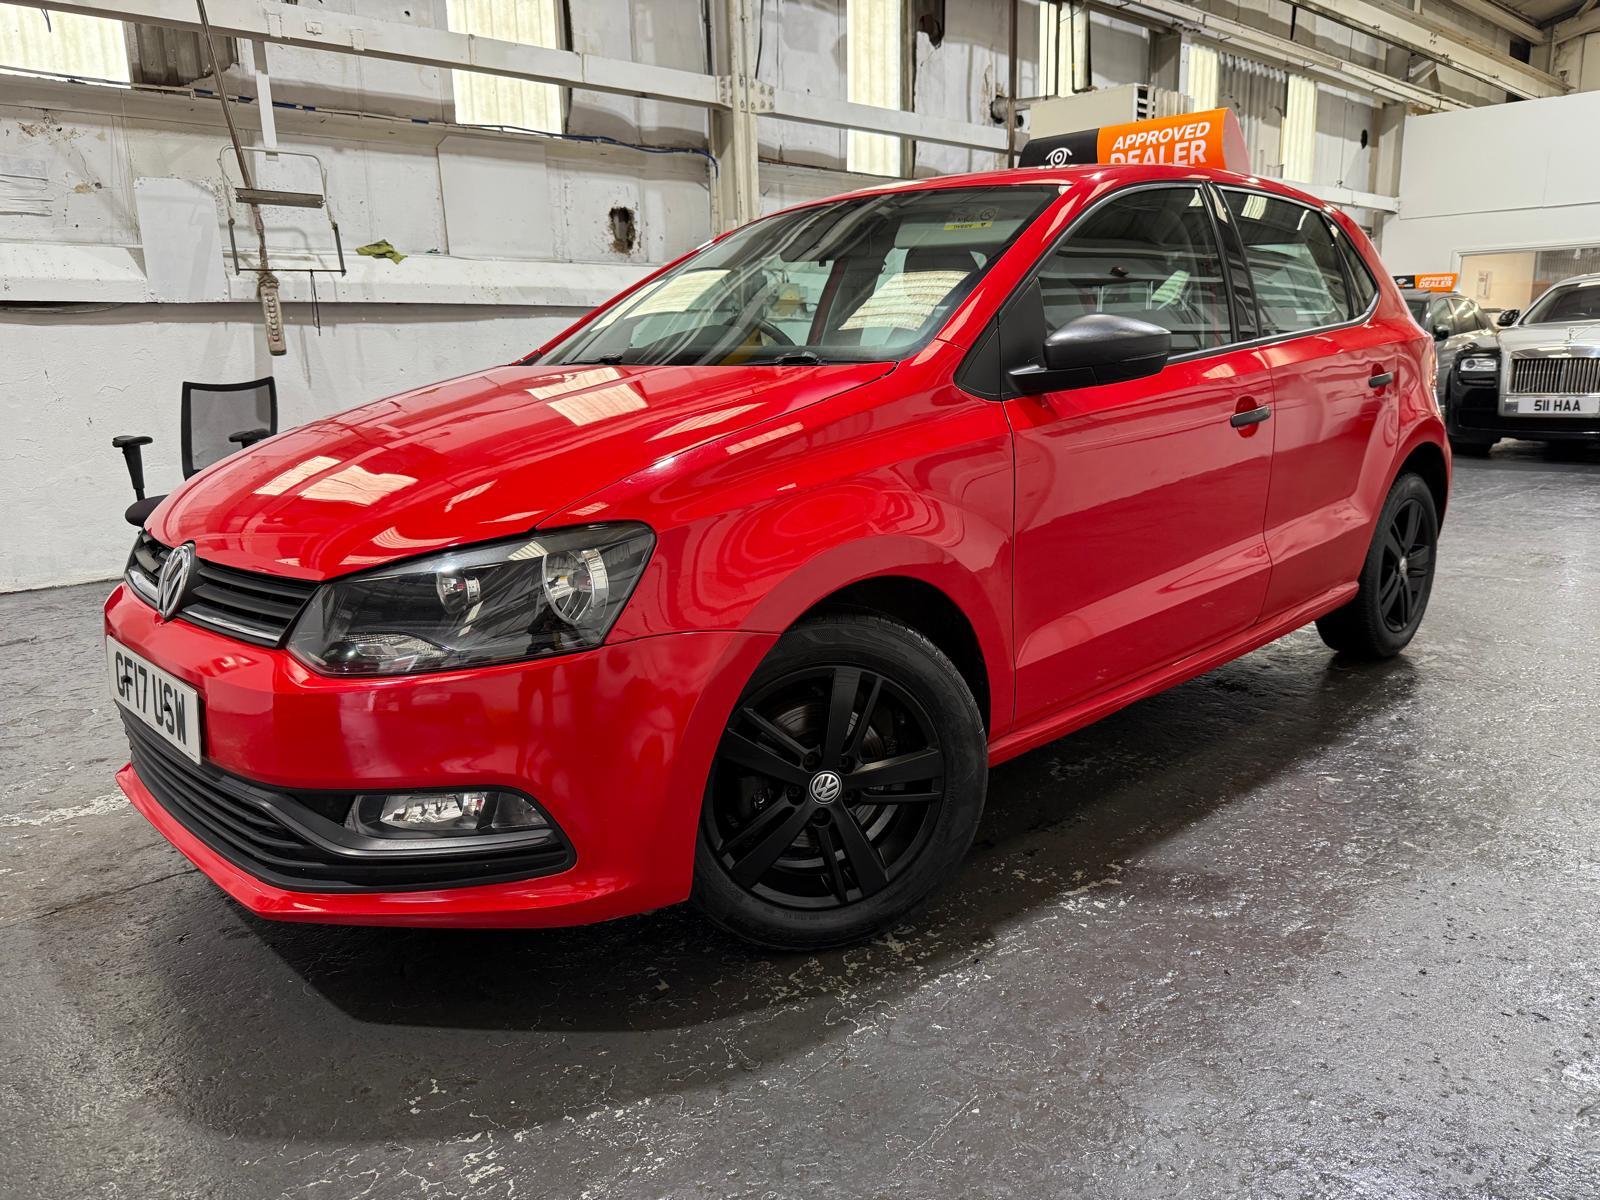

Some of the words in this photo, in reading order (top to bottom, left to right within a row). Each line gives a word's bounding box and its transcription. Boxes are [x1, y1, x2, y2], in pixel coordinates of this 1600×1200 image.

[1112, 121, 1211, 151] APPROVED
[1418, 280, 1453, 289] DEALER
[1553, 399, 1581, 412] HAA
[115, 651, 148, 714] GF17
[151, 674, 187, 746] USW
